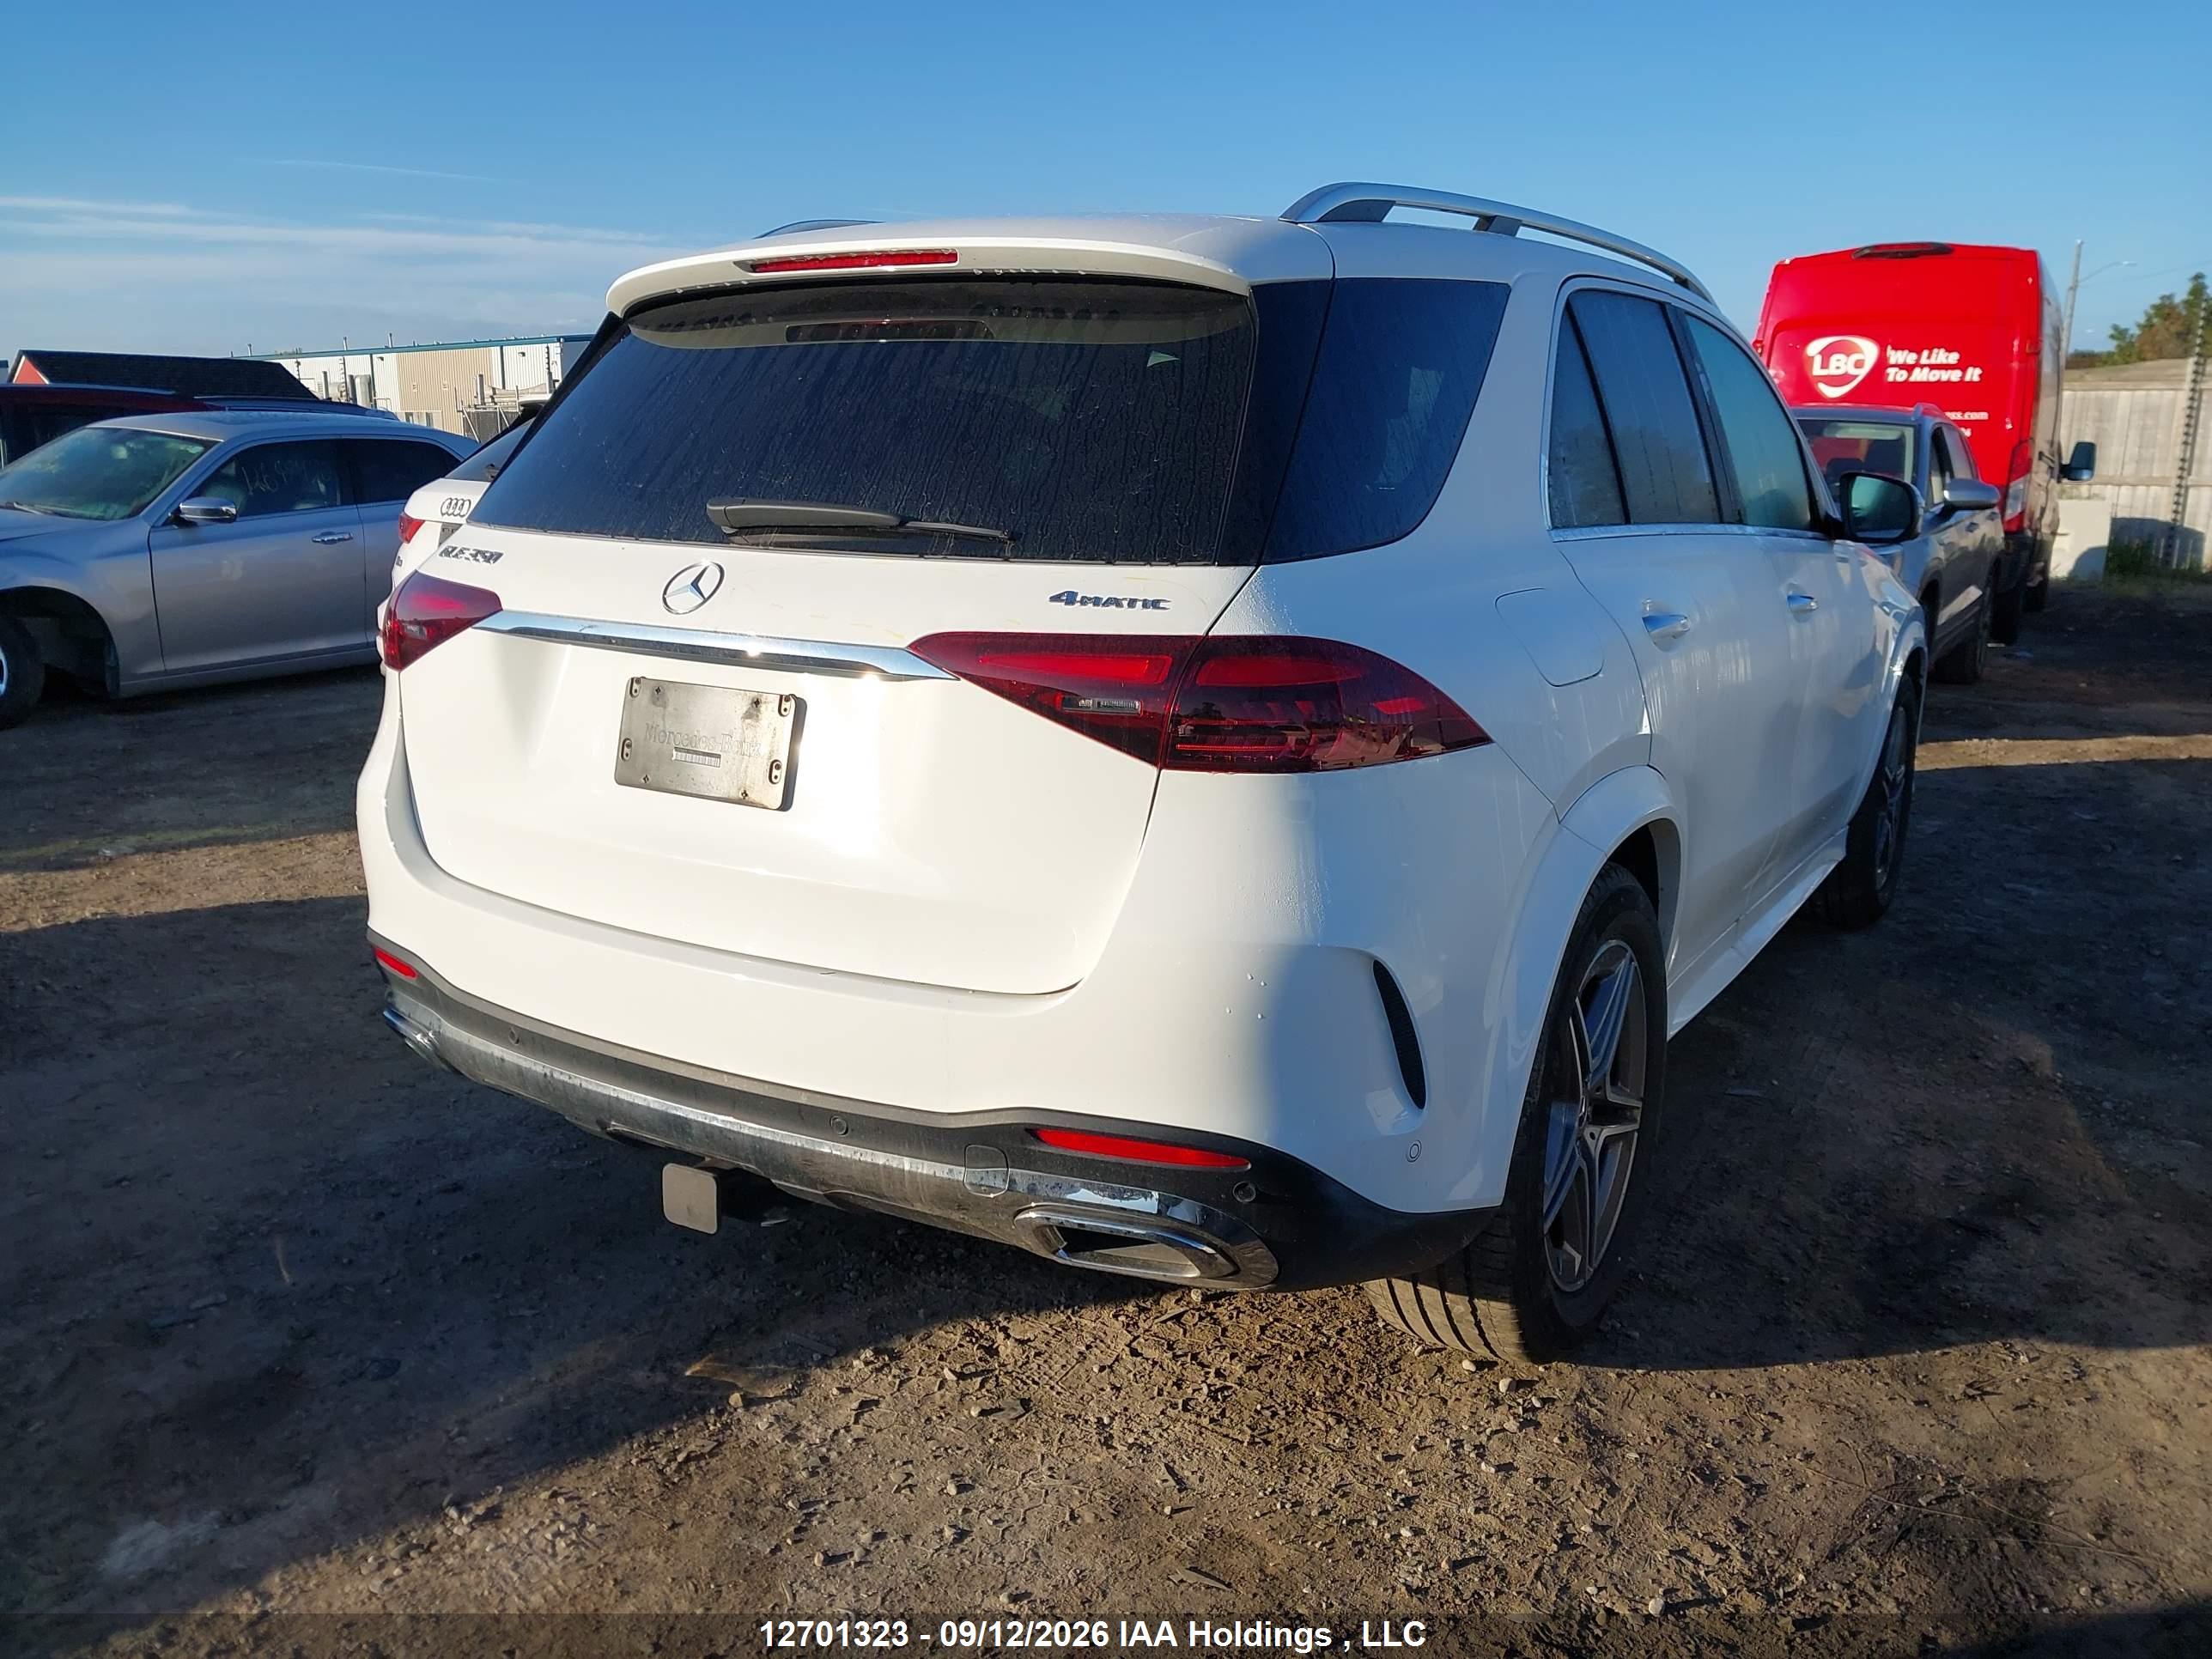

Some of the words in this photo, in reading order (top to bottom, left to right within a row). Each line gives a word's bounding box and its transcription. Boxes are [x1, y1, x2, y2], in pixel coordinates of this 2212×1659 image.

[1811, 353, 1867, 376] LBC
[1887, 346, 1917, 365] We
[1919, 347, 1960, 365] Like
[1886, 367, 1909, 382] To
[1909, 367, 1963, 382] Move
[1964, 366, 1984, 382] It
[1048, 590, 1172, 611] 4MATIC
[644, 722, 762, 757] Mercedes-Benz
